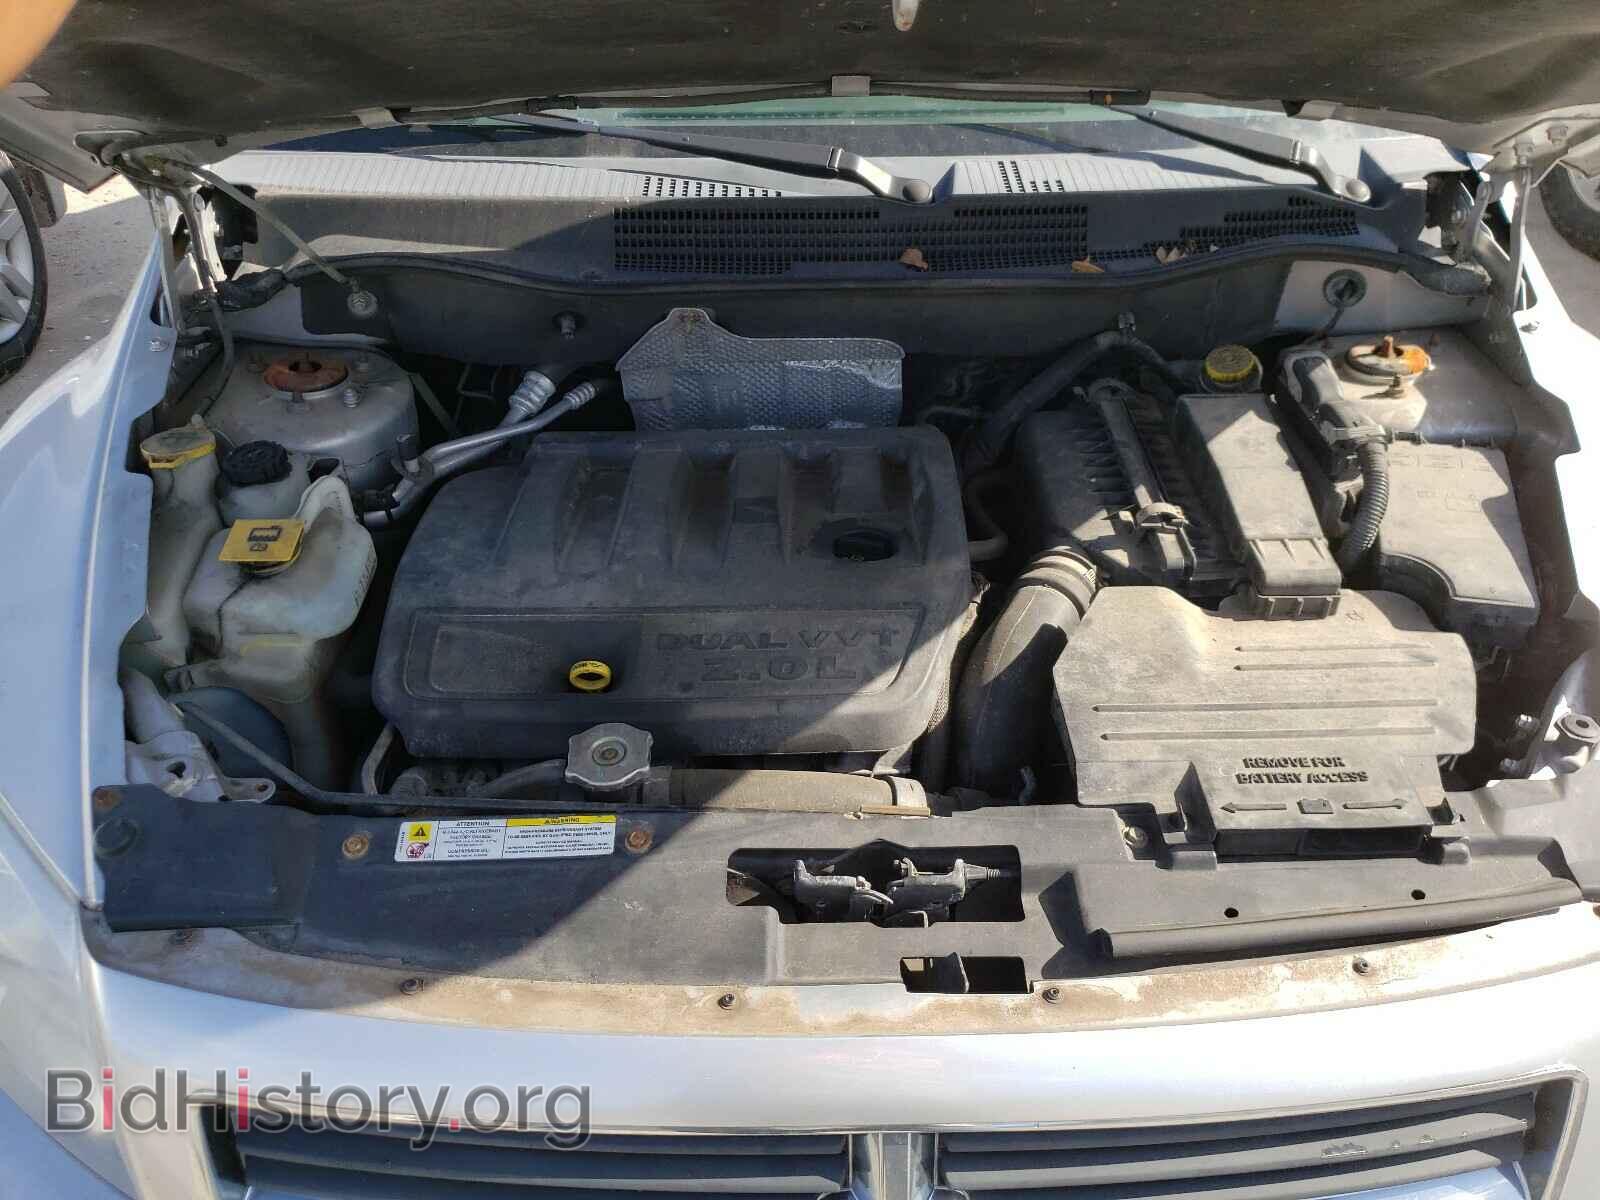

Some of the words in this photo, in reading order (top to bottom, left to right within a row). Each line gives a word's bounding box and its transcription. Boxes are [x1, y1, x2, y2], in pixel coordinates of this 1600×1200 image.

[656, 631, 789, 650] DUAL
[798, 629, 899, 650] VVT
[702, 655, 857, 681] 2.0L
[1243, 757, 1310, 768] REMOVE
[1312, 756, 1345, 768] FOR
[1236, 773, 1301, 785] BATTERY
[1305, 771, 1368, 783] ACCESS
